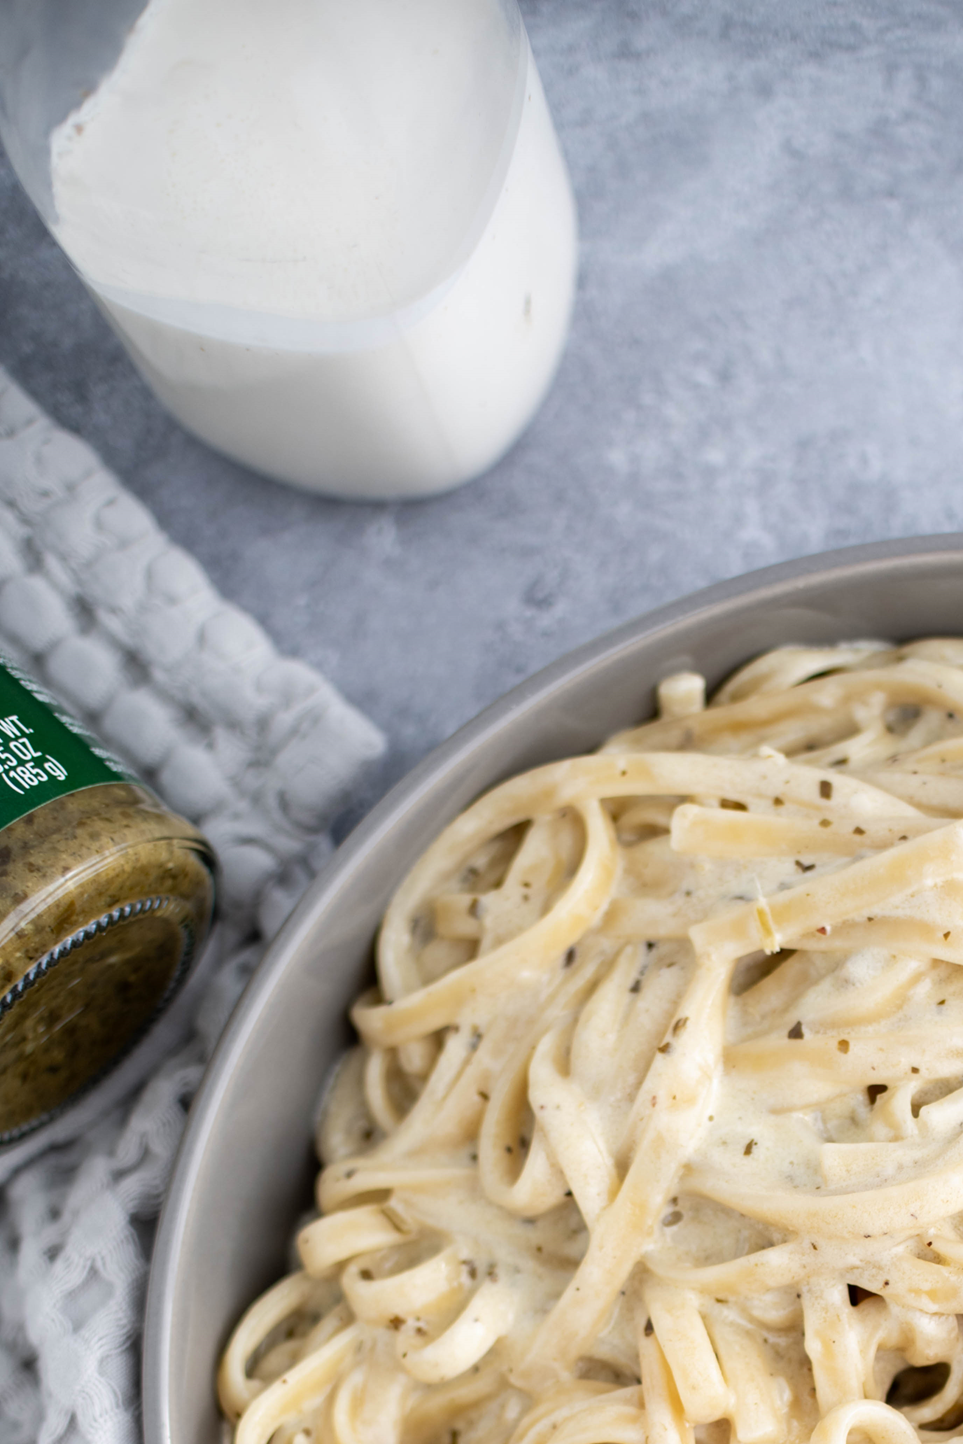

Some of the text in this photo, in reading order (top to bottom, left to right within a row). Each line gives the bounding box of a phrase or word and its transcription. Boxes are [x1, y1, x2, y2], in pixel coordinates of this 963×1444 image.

[0, 715, 34, 738] WT.
[0, 737, 42, 773] .5 OZ
[1, 762, 48, 795] (185
[43, 754, 68, 780] g)
